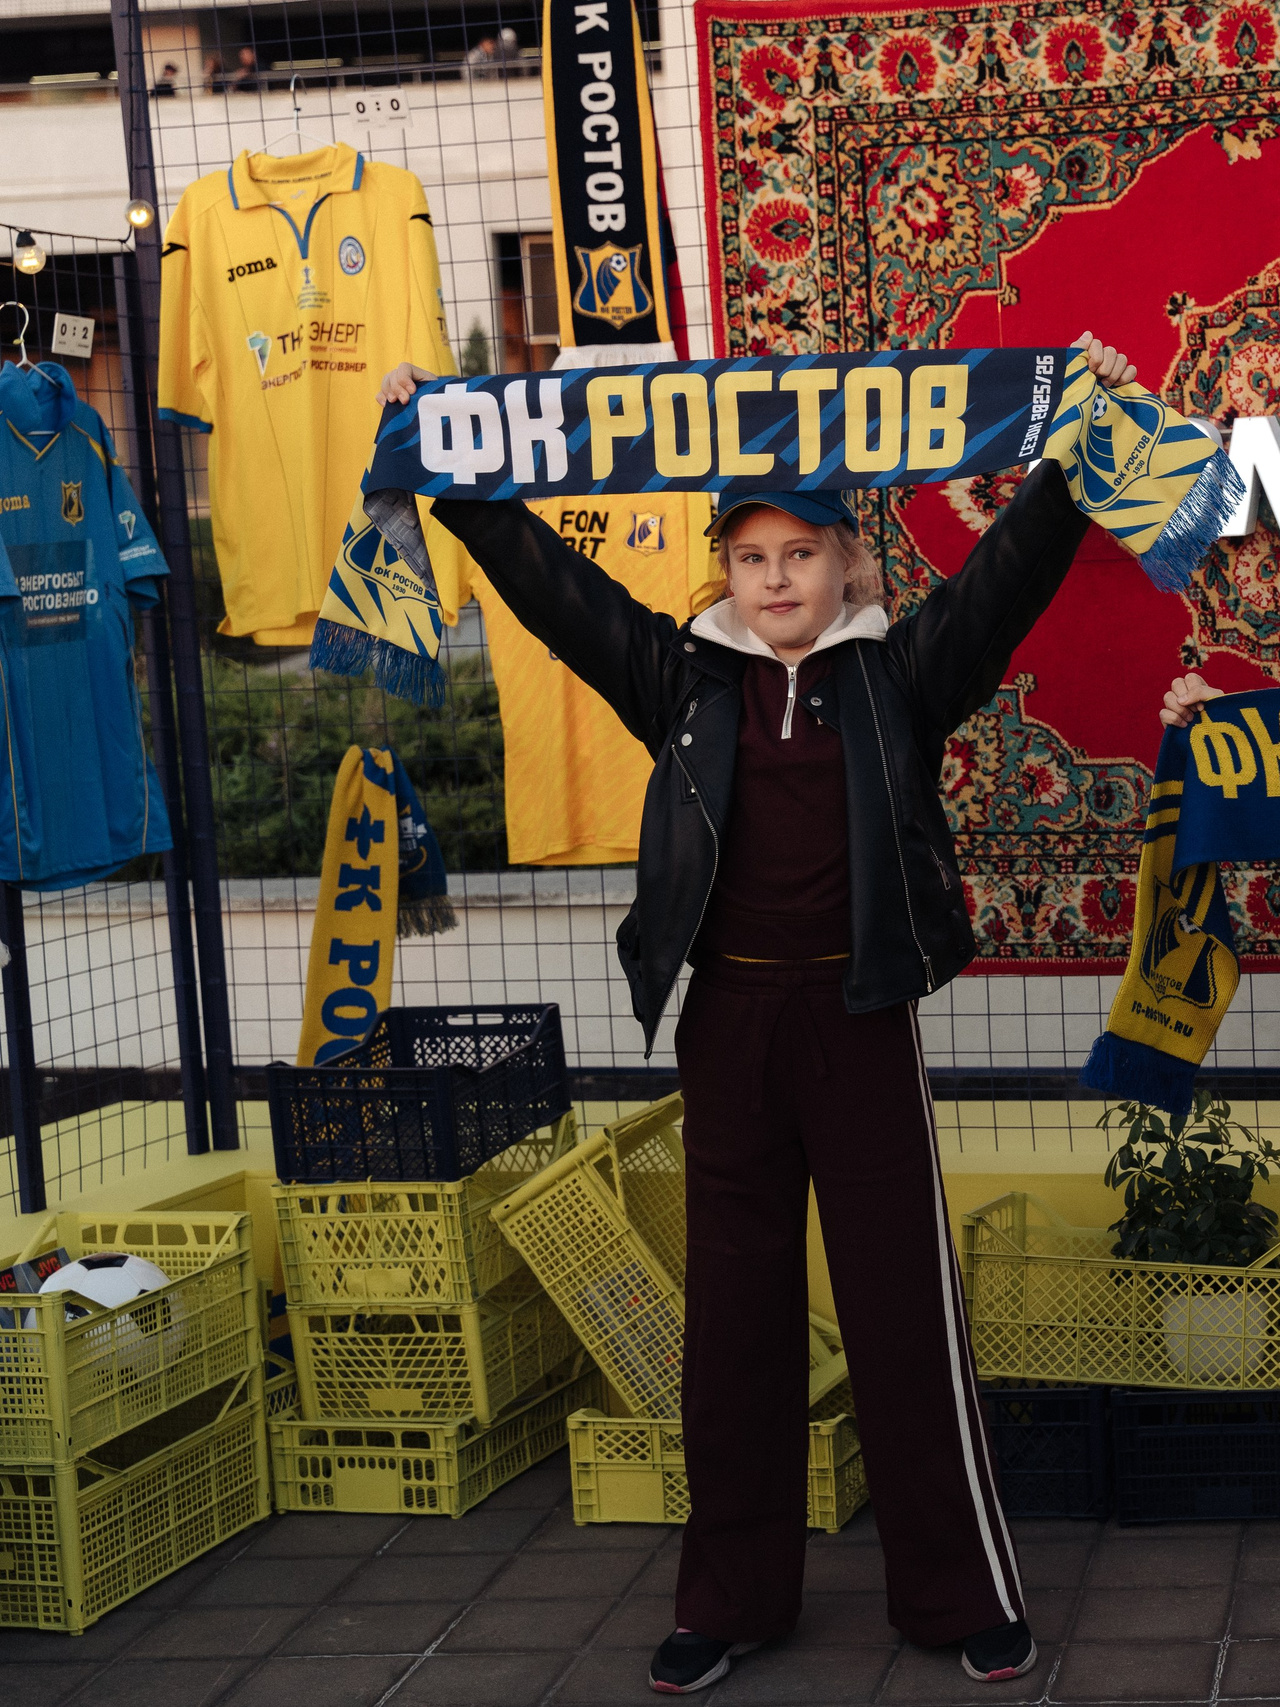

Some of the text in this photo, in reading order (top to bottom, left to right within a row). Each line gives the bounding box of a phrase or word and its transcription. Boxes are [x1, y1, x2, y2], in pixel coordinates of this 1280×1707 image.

[356, 101, 366, 114] 0
[390, 98, 400, 111] 0
[574, 0, 626, 232] К РОСТОВ
[60, 323, 67, 336] 0
[82, 326, 89, 340] 2
[1018, 355, 1055, 458] СЕЗОН 2025/26
[419, 364, 968, 485] ФК РОСТОВ
[1113, 435, 1151, 486] ФК РОСТОВ
[1132, 459, 1145, 475] 1930
[560, 510, 609, 533] FON
[374, 566, 424, 595] ФК РОСТОВ
[392, 584, 406, 594] 1930
[38, 1256, 61, 1278] JVC
[0, 1274, 15, 1291] VC
